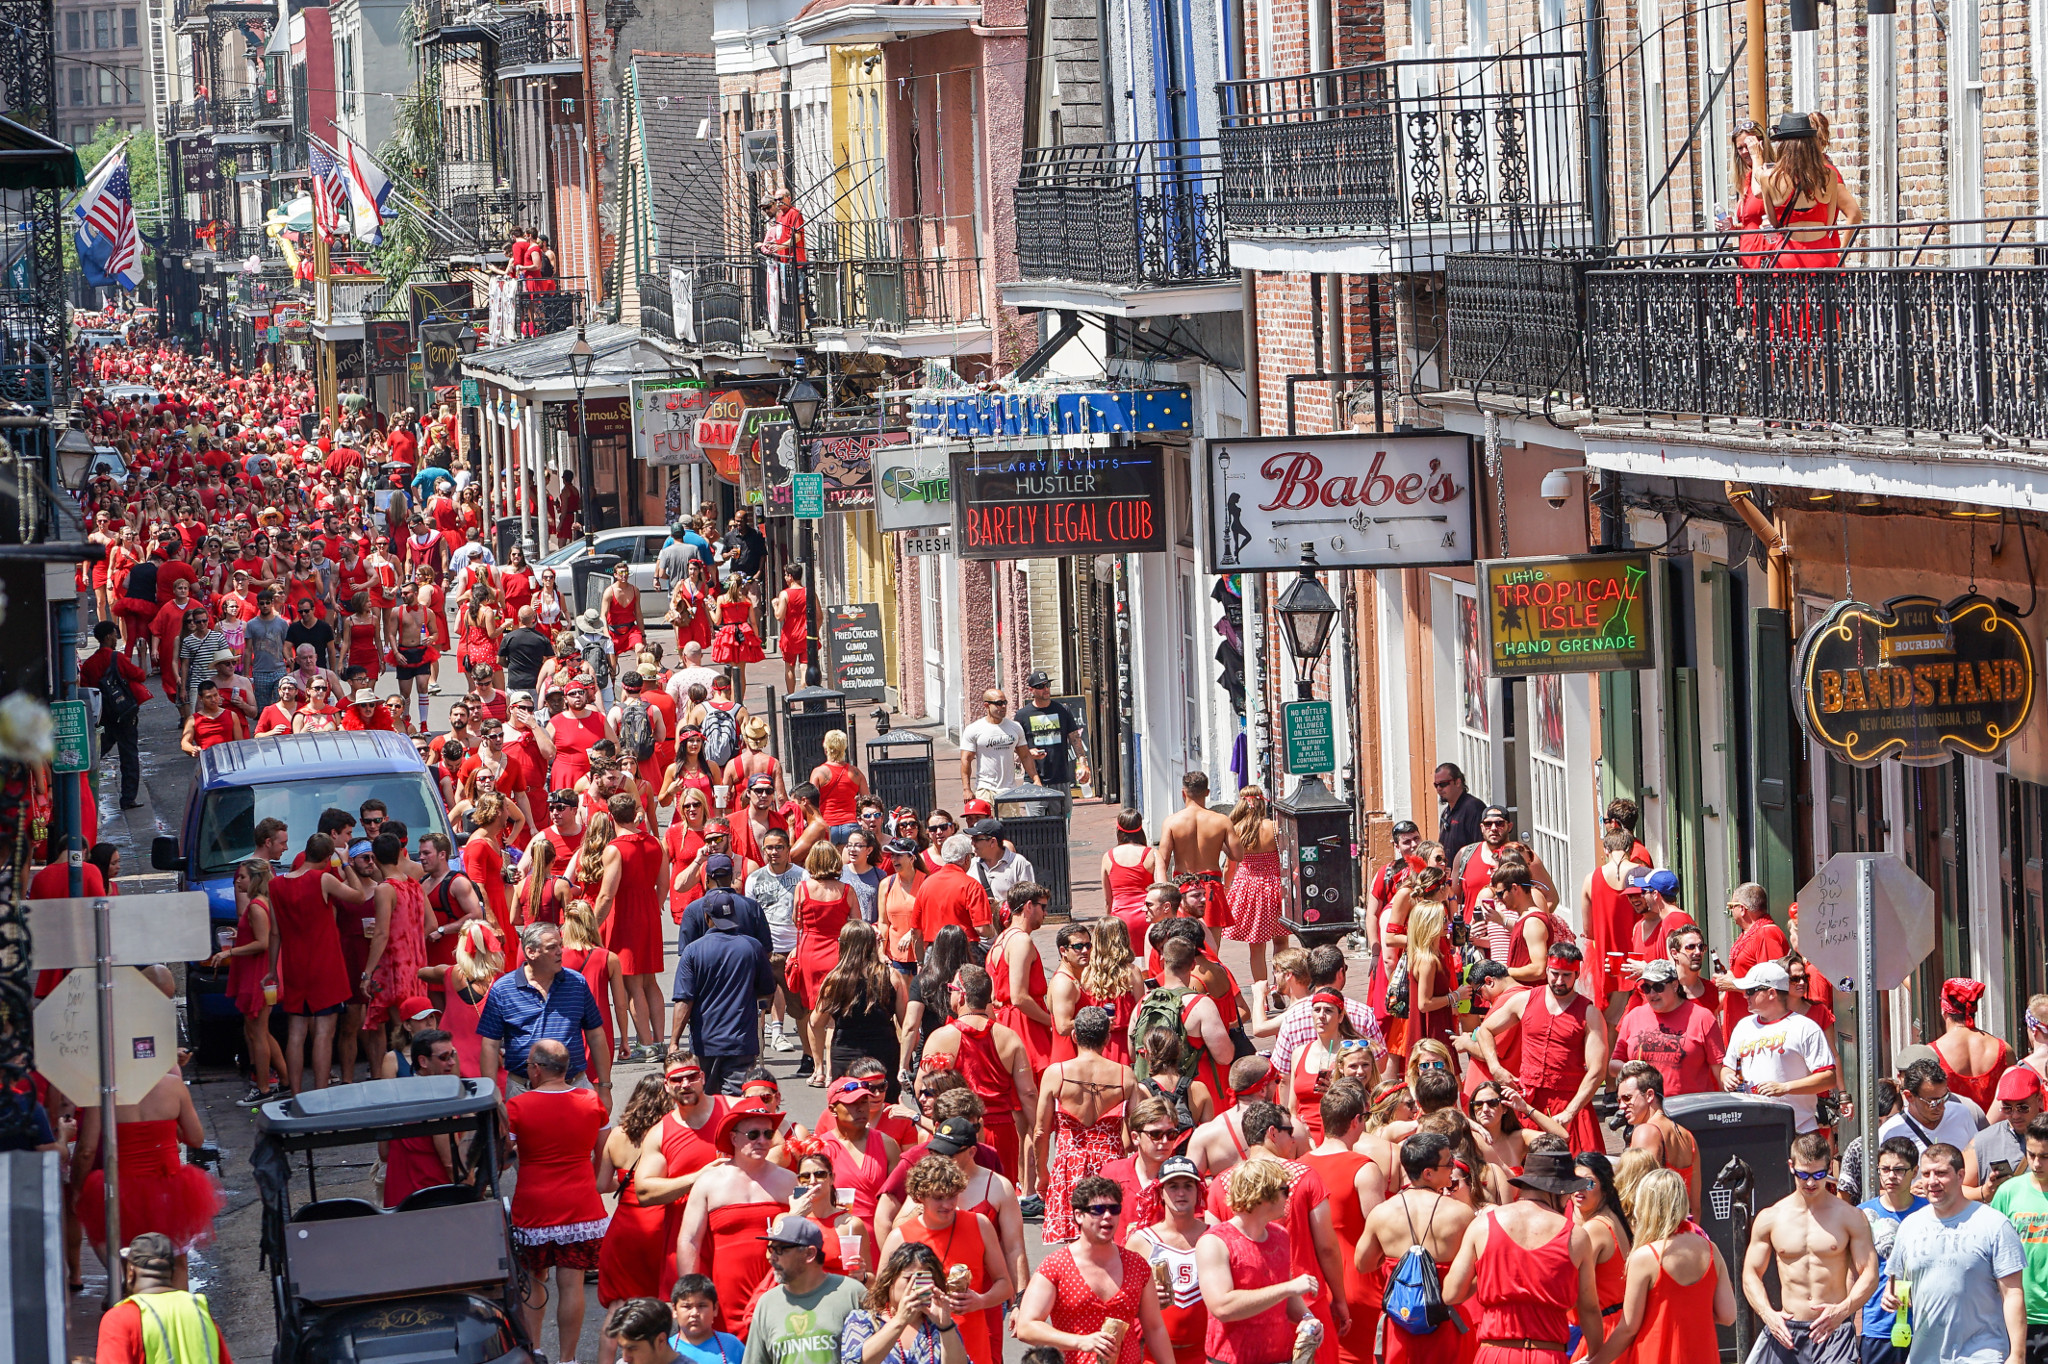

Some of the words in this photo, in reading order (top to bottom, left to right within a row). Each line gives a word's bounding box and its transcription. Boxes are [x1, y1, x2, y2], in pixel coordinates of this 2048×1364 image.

[713, 402, 739, 418] BIG
[828, 436, 890, 453] PANDA
[998, 461, 1047, 472] LARRY
[1057, 458, 1119, 471] FLYNT'S
[1016, 475, 1095, 494] HUSTLER
[1258, 451, 1465, 511] Babe's
[968, 504, 1037, 546] BARELY
[1045, 503, 1102, 543] LEGAL
[1108, 500, 1154, 541] CLUB
[908, 538, 951, 553] FRESH
[1497, 577, 1637, 606] TROPICAL
[1541, 604, 1599, 628] ISLE
[834, 631, 852, 640] FRIED
[853, 629, 878, 639] CHICKEN
[845, 642, 868, 651] GUMBO
[1505, 639, 1551, 655] HAND
[1559, 635, 1636, 651] GRENADE
[1895, 638, 1944, 651] BOURBON
[840, 653, 875, 663] JAMBALAYA
[1497, 659, 1514, 667] NEW
[1516, 657, 1551, 667] ORLEANS
[1554, 655, 1573, 664] MOST
[846, 666, 875, 675] SEAFOOD
[1819, 658, 2024, 714] BANDSTAND
[1301, 707, 1327, 716] BOTTLES
[1860, 717, 1878, 731] NEW
[1880, 715, 1916, 730] ORLEANS
[1918, 711, 1963, 727] LOUISIANA,
[1966, 710, 1982, 725] USA
[1304, 728, 1326, 736] STREET
[1708, 1111, 1742, 1122] BigBelly
[772, 1335, 837, 1358] GUINNESS
